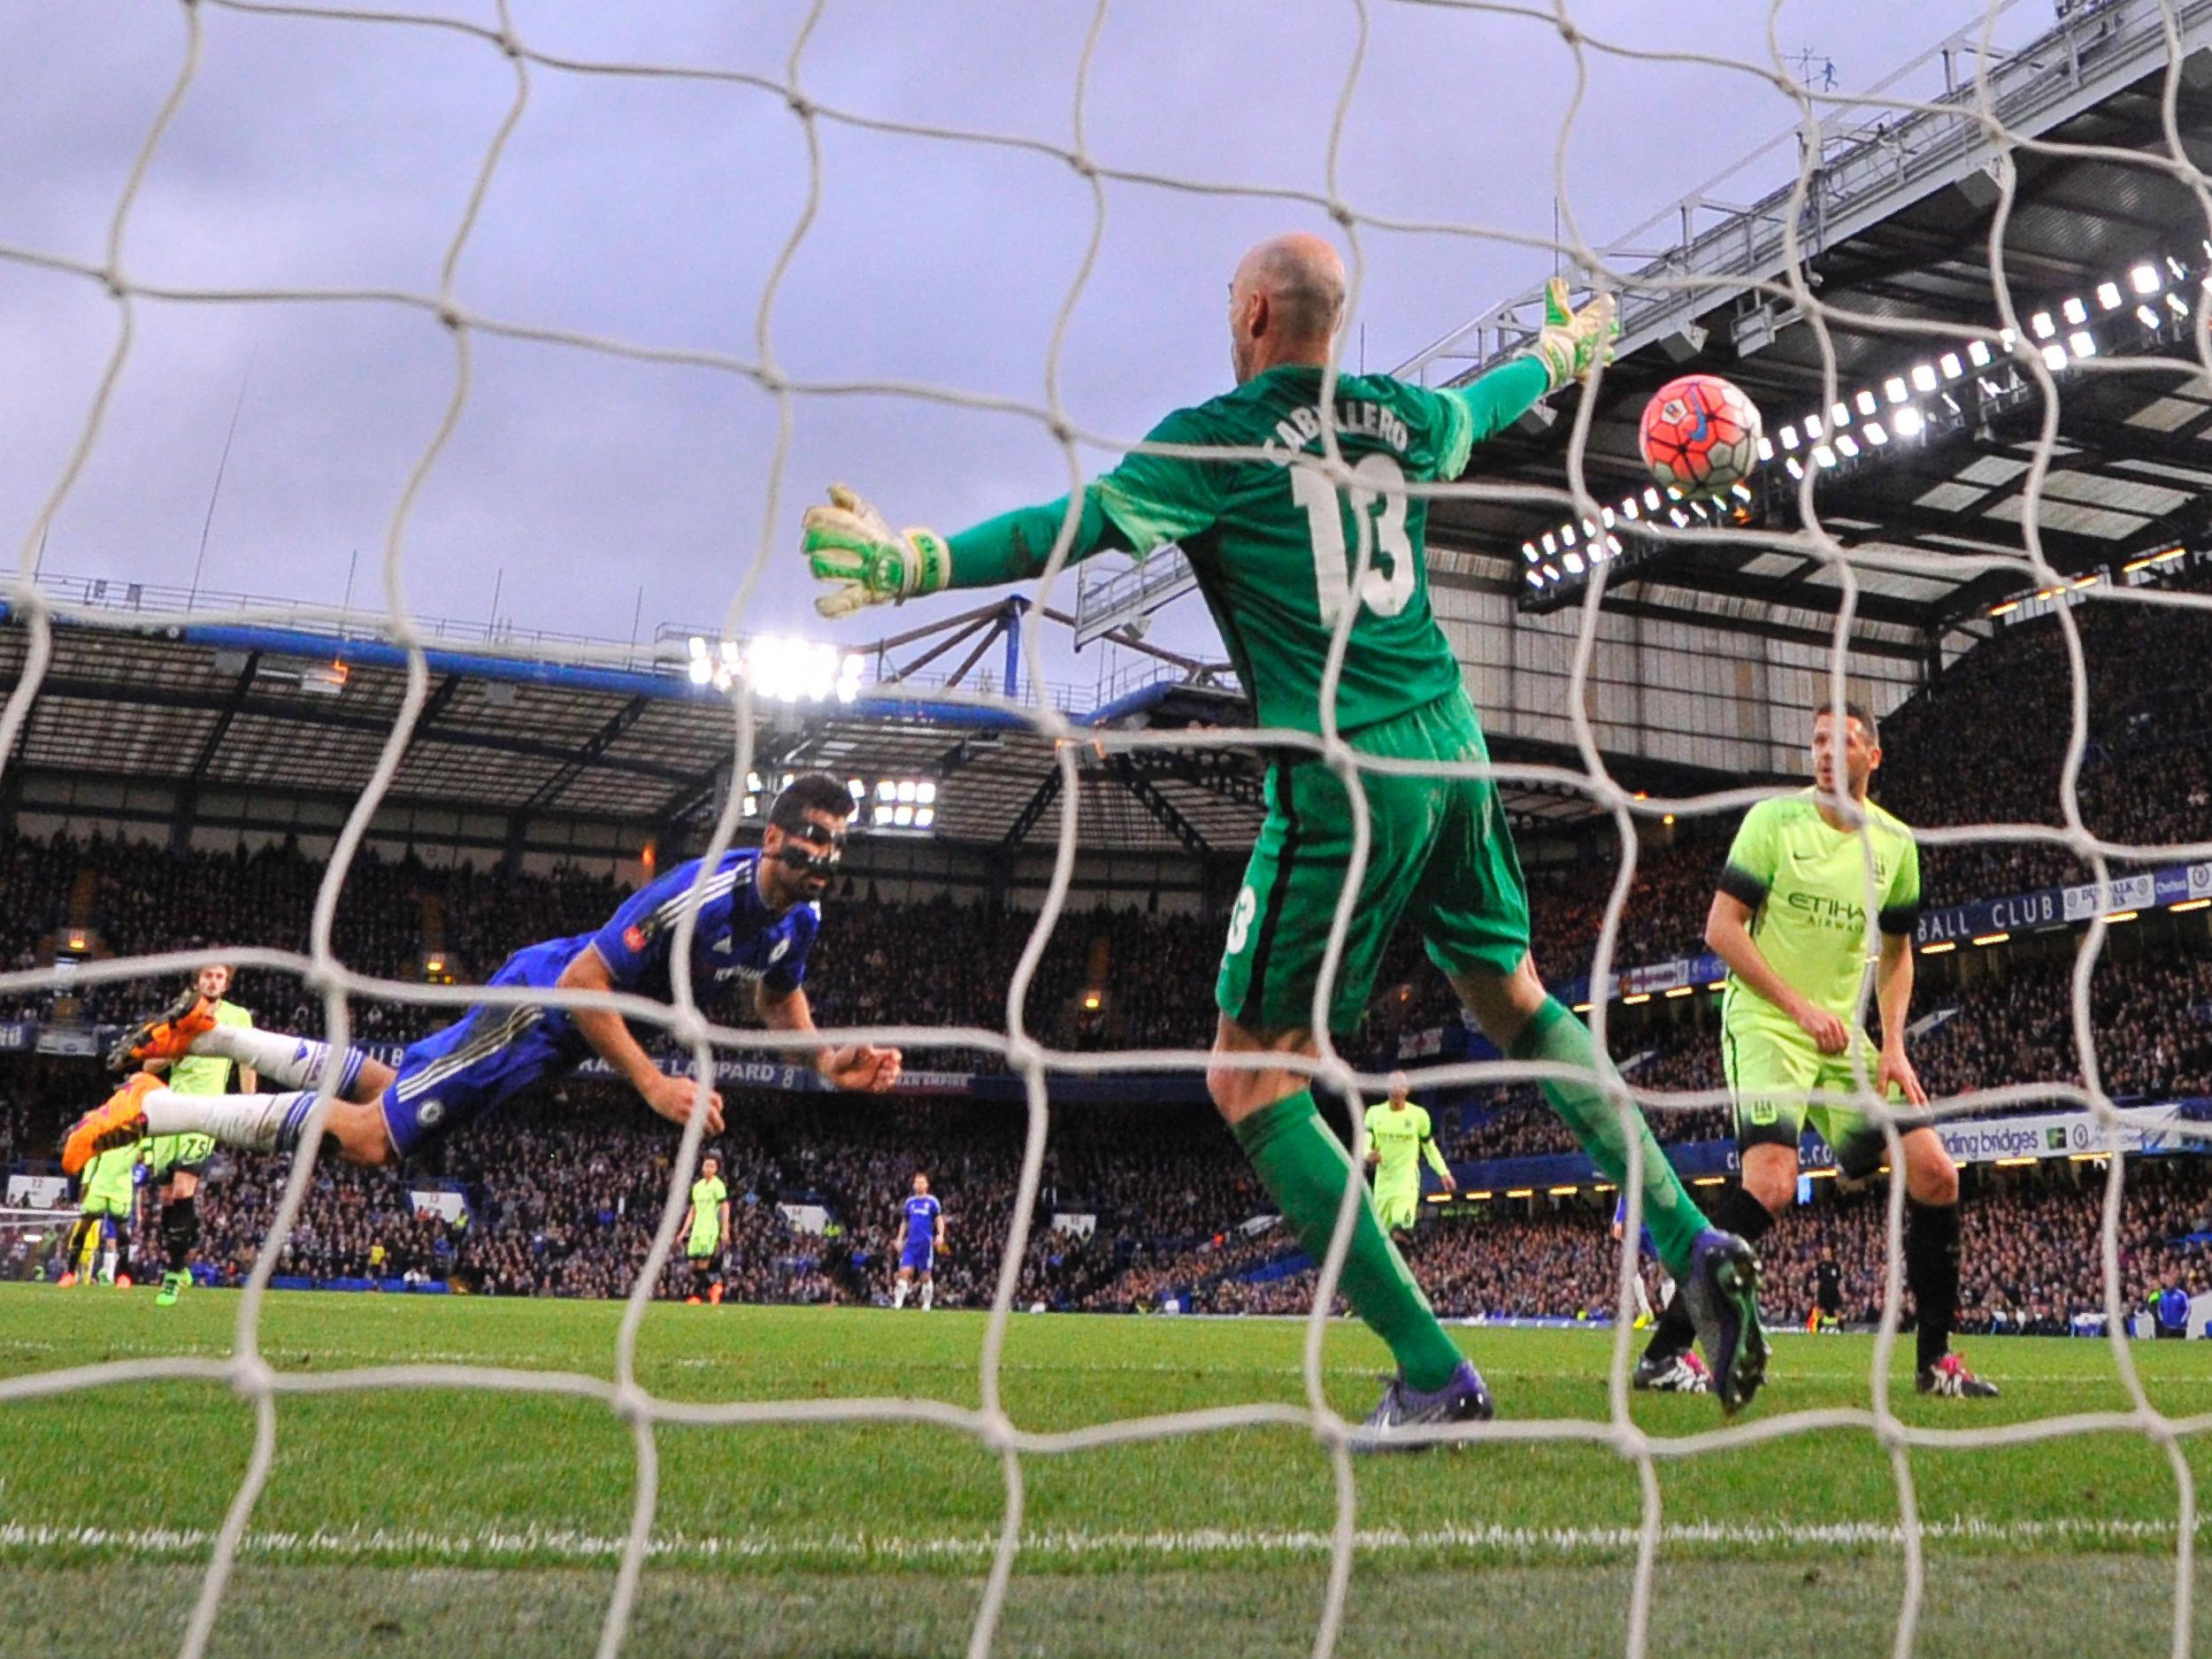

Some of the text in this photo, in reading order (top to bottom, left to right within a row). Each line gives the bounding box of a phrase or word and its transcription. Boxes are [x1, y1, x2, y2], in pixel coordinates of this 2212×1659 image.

[1263, 400, 1409, 466] CABLLERO
[1290, 452, 1416, 629] 13
[1787, 892, 1868, 921] ETIHA
[1992, 895, 2054, 928] CLUB
[1980, 1128, 2039, 1156] bridges
